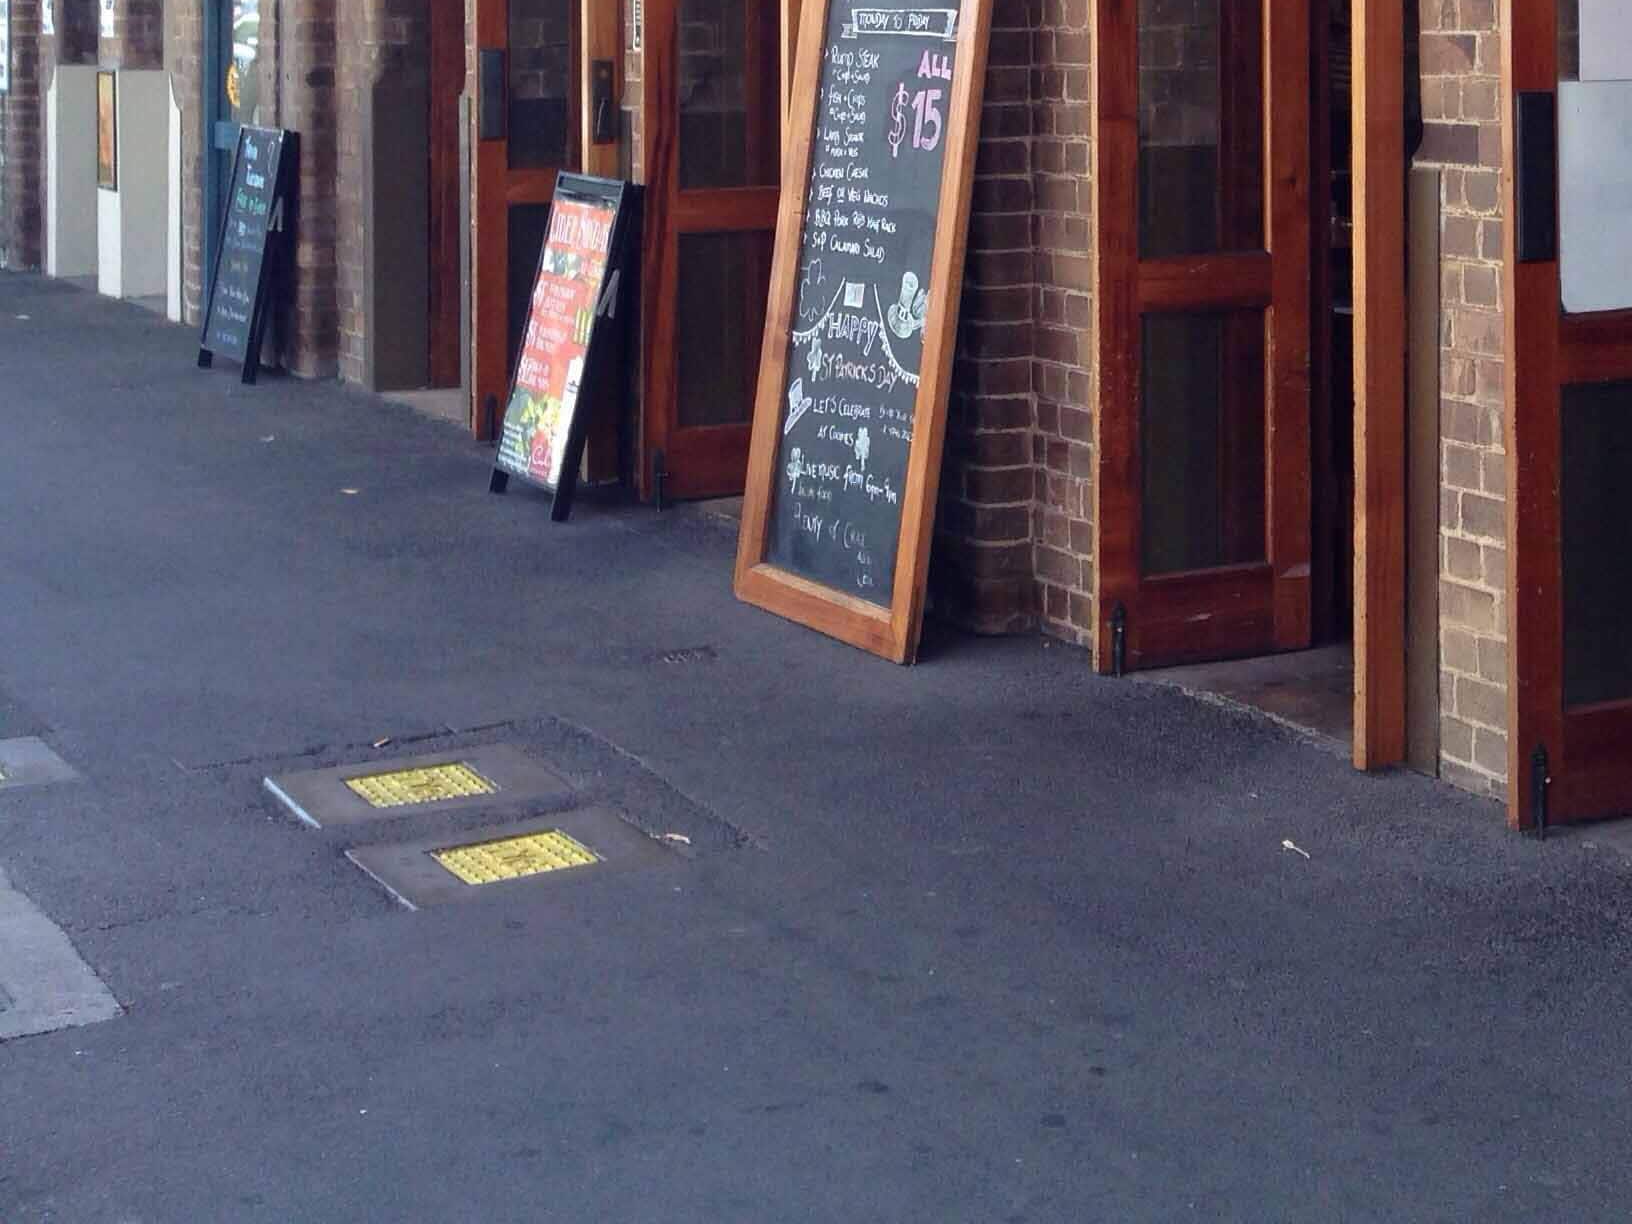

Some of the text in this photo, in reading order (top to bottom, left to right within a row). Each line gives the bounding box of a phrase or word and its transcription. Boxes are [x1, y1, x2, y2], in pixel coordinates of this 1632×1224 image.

[918, 49, 952, 81] ALL
[888, 82, 943, 158] $15
[828, 312, 879, 357] HAPPY
